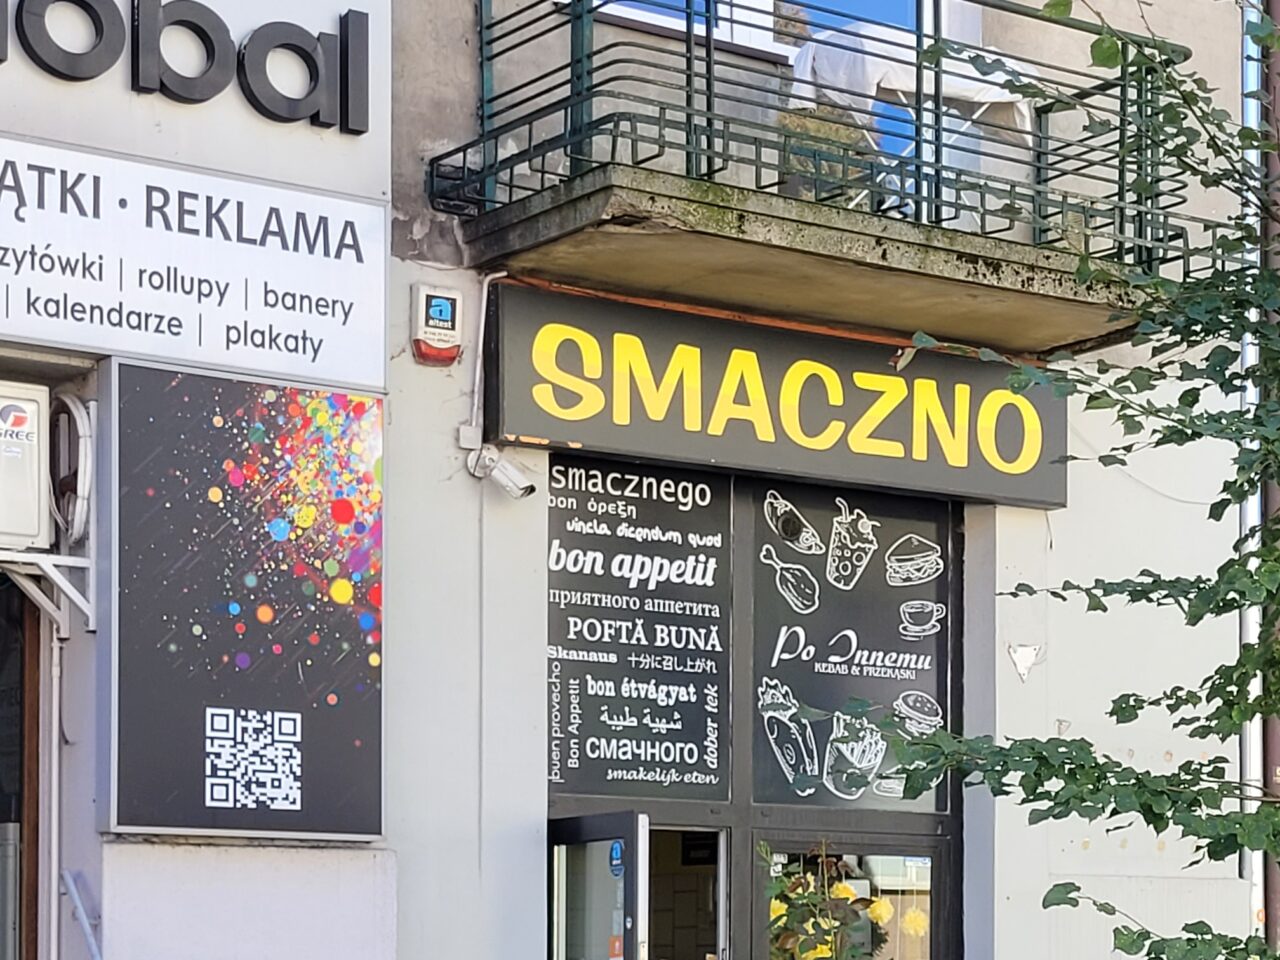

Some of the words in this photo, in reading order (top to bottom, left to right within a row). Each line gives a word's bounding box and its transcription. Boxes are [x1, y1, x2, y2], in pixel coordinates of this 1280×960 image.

[0, 0, 369, 136] obal
[145, 184, 365, 264] REKLAMA
[138, 265, 230, 306] rollupy
[263, 281, 354, 326] banery
[26, 287, 184, 337] kalendarze
[225, 321, 324, 364] plakaty
[531, 322, 1043, 475] SMACZNO
[551, 465, 712, 511] smacznego
[548, 539, 605, 575] bon
[611, 553, 718, 591] appetit
[549, 588, 641, 609] приятного
[644, 597, 721, 618] аппетита
[547, 645, 618, 664] Skanaus
[567, 616, 649, 646] POFTĂ
[654, 625, 724, 652] BUNĂ
[586, 674, 616, 698] bon
[621, 677, 697, 706] étvágyat
[814, 661, 849, 675] KEBAB
[549, 661, 566, 738] provecho
[567, 678, 582, 735] Appetit
[703, 683, 719, 713] tek
[549, 739, 566, 783] buen
[567, 738, 580, 769] Bon
[586, 737, 699, 764] смачного
[703, 717, 719, 769] dober
[607, 766, 683, 786] smakelijk
[683, 771, 720, 785] eten
